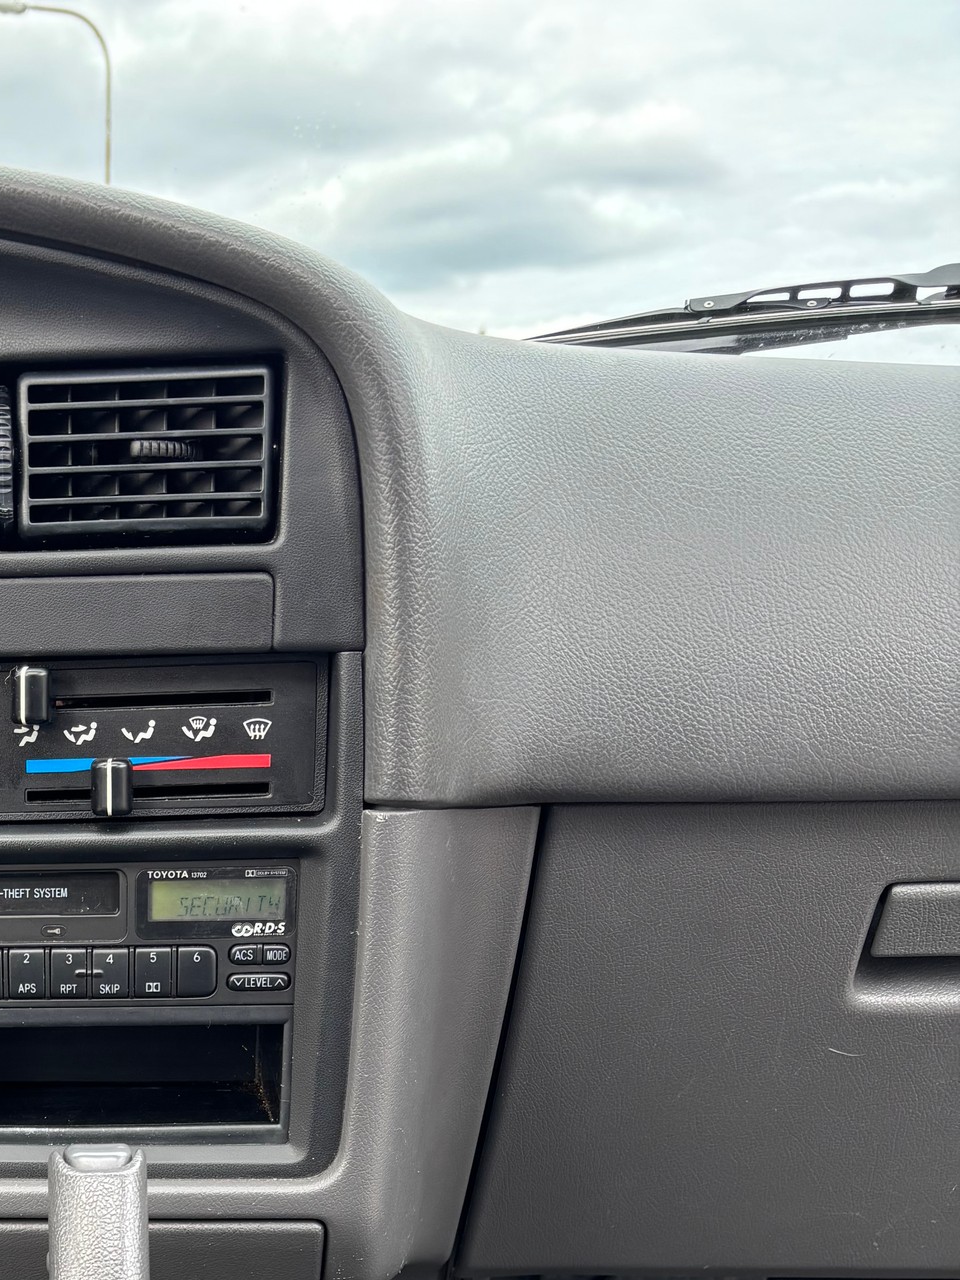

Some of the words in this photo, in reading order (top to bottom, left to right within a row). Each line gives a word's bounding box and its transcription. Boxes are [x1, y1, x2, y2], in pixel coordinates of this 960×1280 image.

[147, 870, 189, 879] TOYOTA
[33, 887, 68, 898] SYSTEM
[23, 953, 30, 964] 2
[65, 953, 73, 964] 3
[106, 953, 114, 964] 4
[149, 952, 157, 963] 5
[193, 952, 201, 963] 6
[234, 950, 253, 961] ACS
[267, 950, 287, 961] MODE
[18, 983, 37, 994] APS
[245, 978, 272, 988] LEVEL
[60, 984, 77, 994] RPT
[99, 984, 120, 994] SKIP
